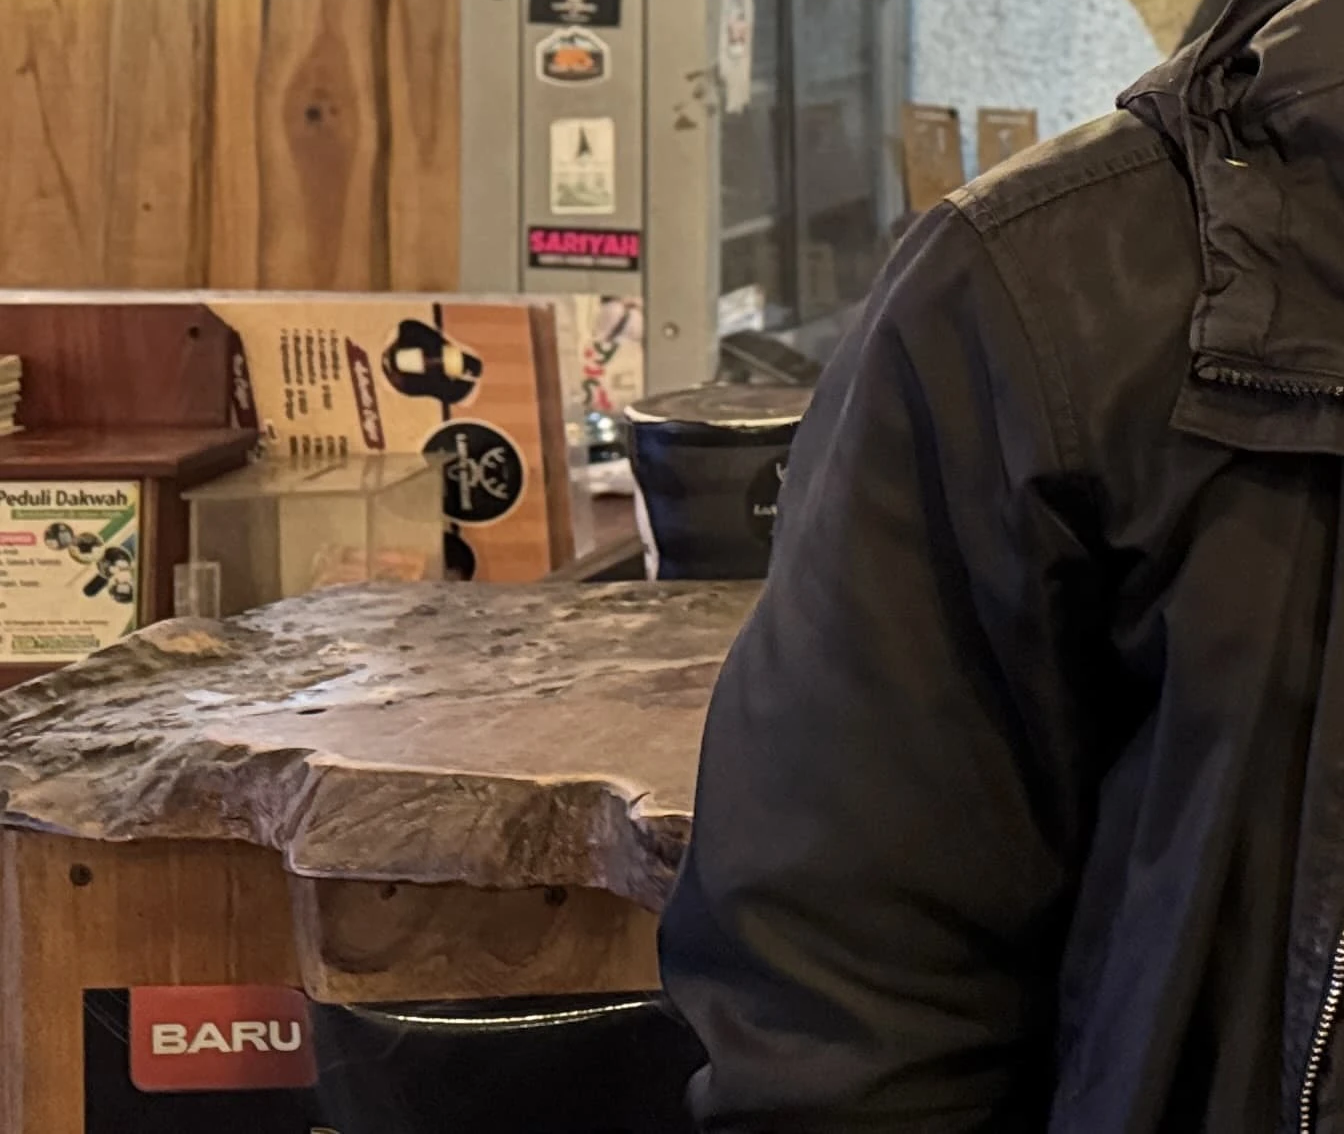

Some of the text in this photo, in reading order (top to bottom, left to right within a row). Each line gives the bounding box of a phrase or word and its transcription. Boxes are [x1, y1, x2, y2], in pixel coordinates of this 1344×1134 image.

[531, 229, 640, 257] SARIYAH
[0, 490, 128, 506] Peduli Dakwah
[152, 1020, 302, 1055] BARU
